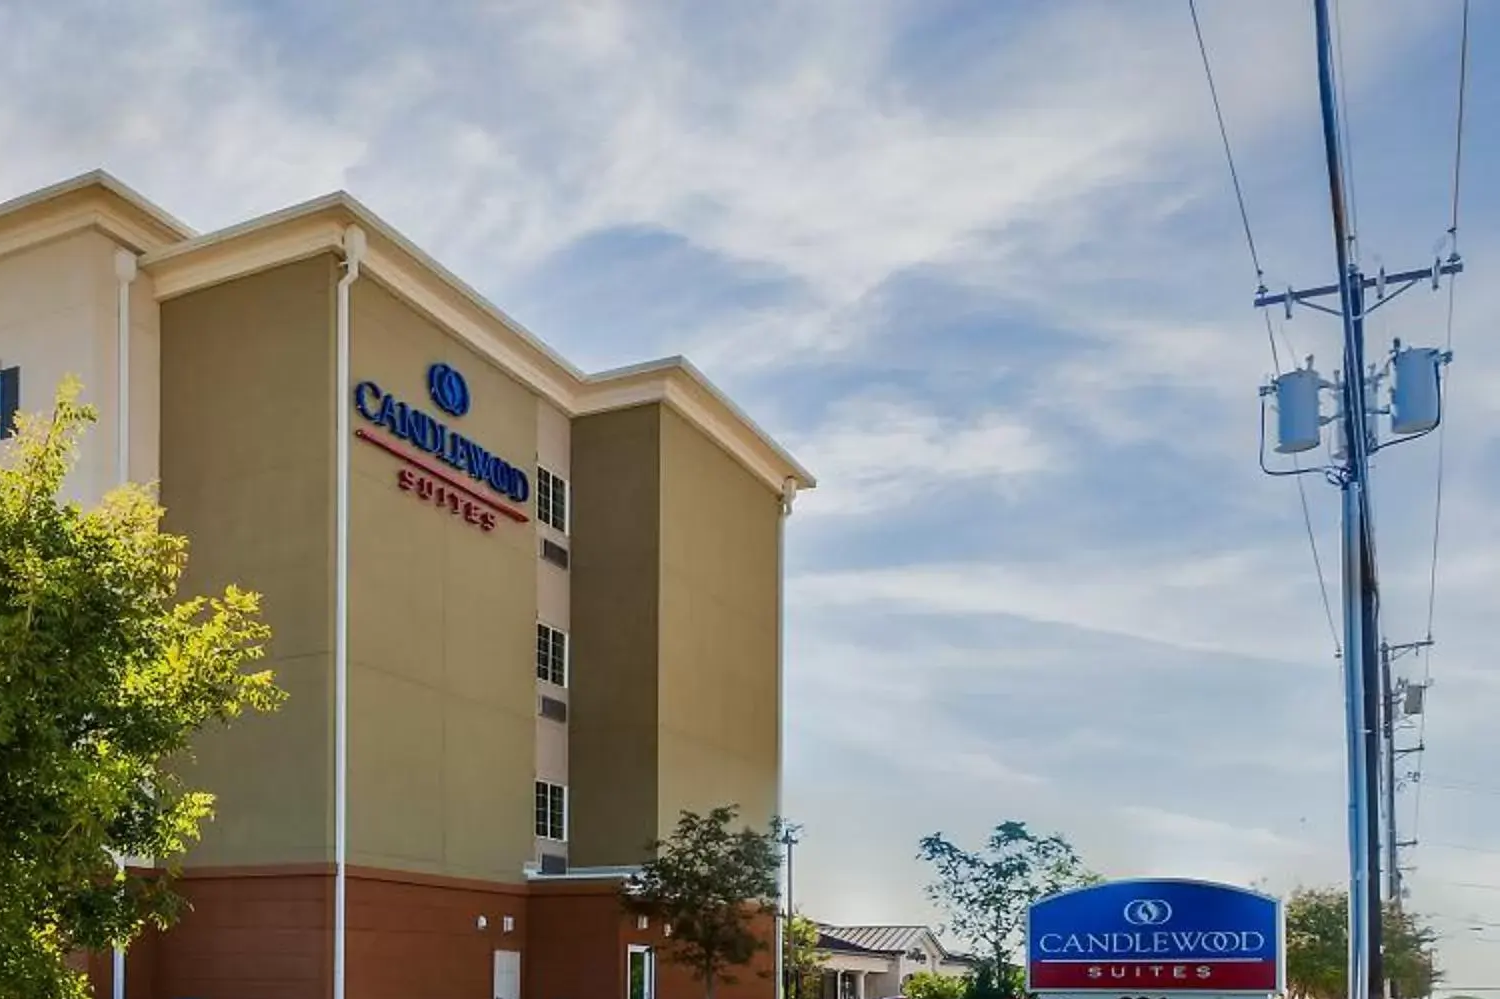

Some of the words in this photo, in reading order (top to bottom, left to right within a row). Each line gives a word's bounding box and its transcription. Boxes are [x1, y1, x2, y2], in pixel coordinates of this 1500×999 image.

[355, 382, 529, 502] CANDLEWOOD
[398, 468, 496, 531] SUITES
[1040, 931, 1265, 953] CANDLEWOOD
[1087, 965, 1212, 978] SUITES
